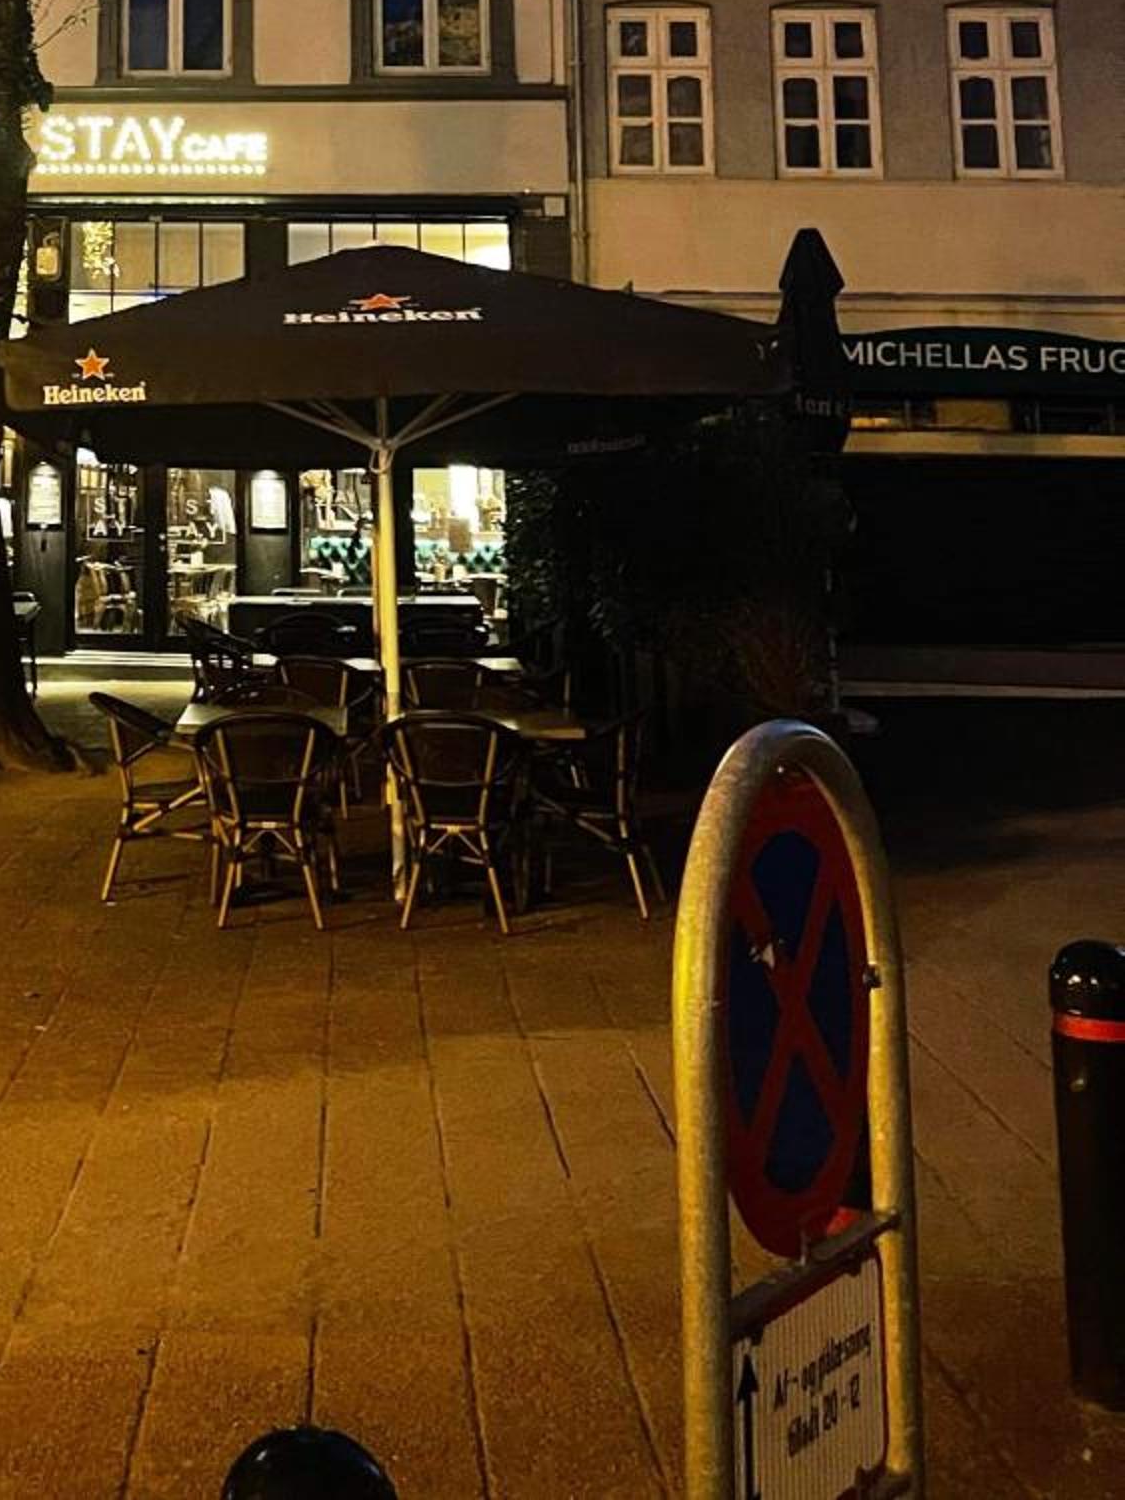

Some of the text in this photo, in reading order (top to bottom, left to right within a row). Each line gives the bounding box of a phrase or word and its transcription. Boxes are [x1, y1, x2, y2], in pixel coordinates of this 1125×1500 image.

[40, 115, 185, 161] STAY
[283, 308, 483, 324] Heineken
[841, 340, 1030, 372] MICHELLAS
[42, 383, 147, 405] Heineken
